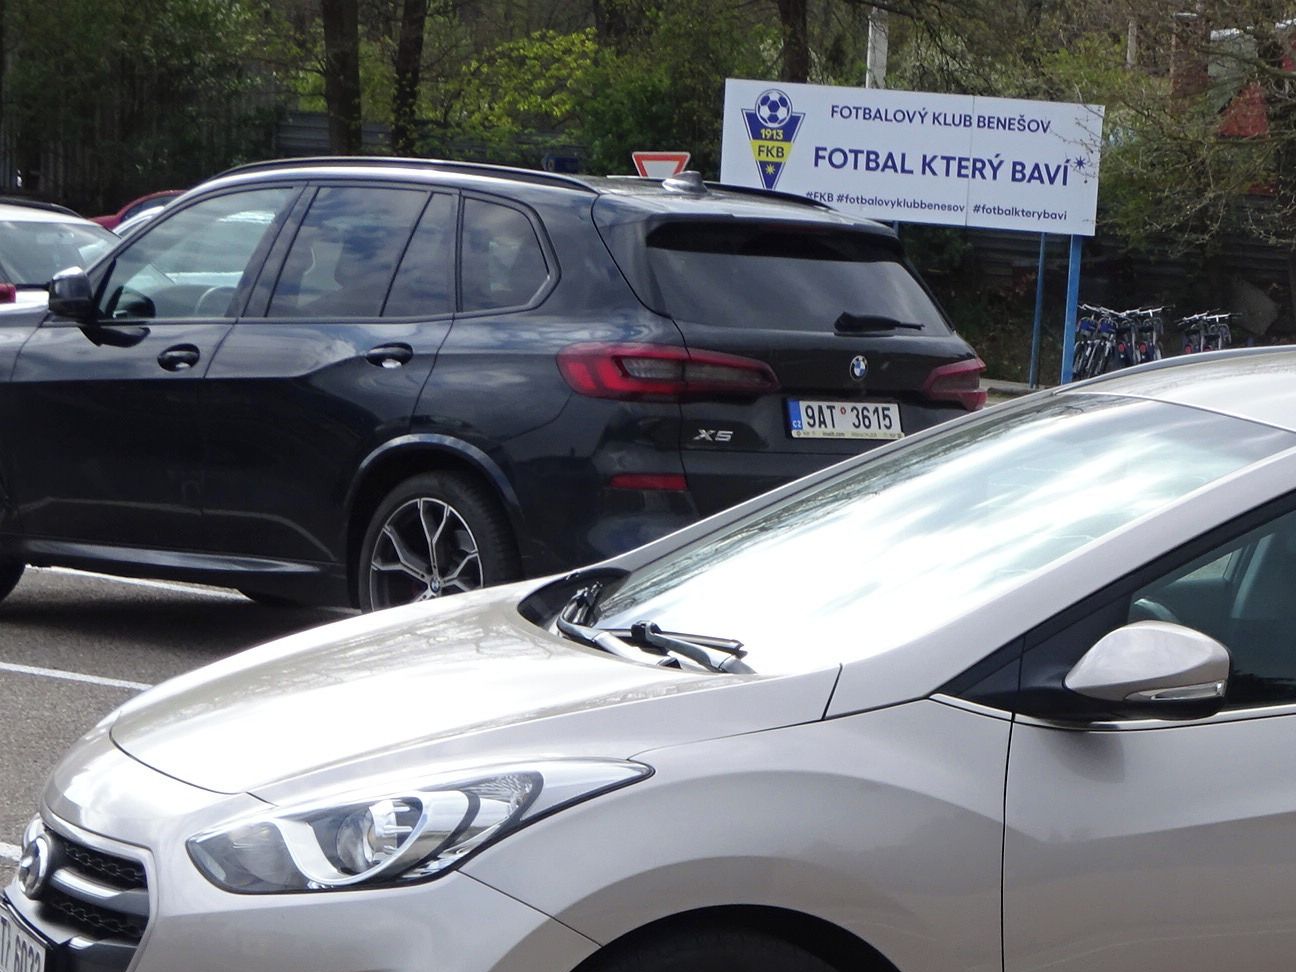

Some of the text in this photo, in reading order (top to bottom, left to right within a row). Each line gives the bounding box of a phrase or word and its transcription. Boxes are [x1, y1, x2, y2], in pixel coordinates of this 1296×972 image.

[831, 104, 1051, 134] FOTBALOVÝ KLUB BENEŠOV
[760, 128, 784, 140] 1913
[757, 145, 785, 159] FKB
[814, 146, 1070, 186] FOTBAL KTERÝ BAVÍ
[836, 194, 966, 213] #fotbalovyklubbenesov
[972, 204, 1068, 221] #fotbalkterybavi
[804, 404, 893, 431] 9AT 3615
[692, 429, 734, 443] X5
